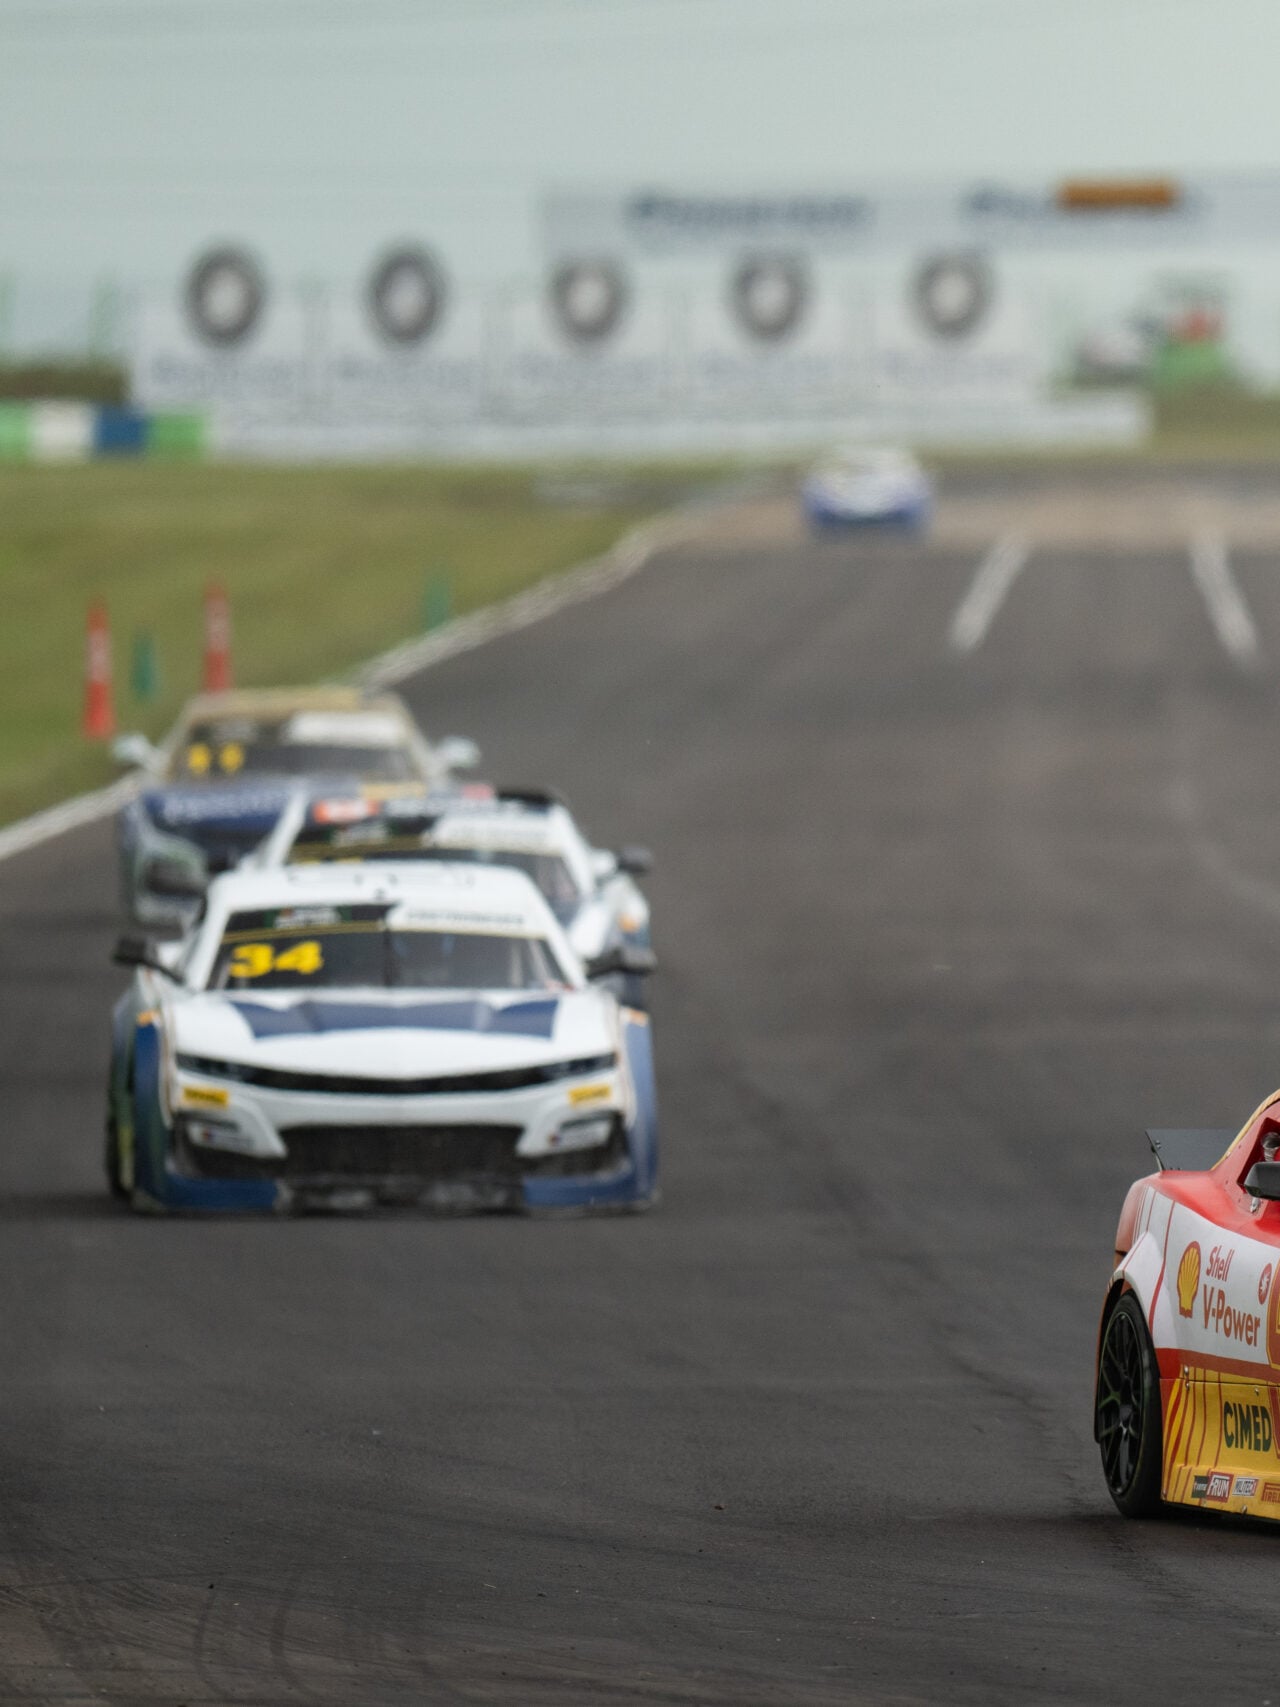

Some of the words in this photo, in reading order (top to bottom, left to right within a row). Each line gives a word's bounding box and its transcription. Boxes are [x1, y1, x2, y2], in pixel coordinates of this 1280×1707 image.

[229, 941, 324, 978] 34
[1206, 1245, 1235, 1282] Shell
[1203, 1284, 1261, 1347] V-Power
[1223, 1401, 1273, 1452] CIMED
